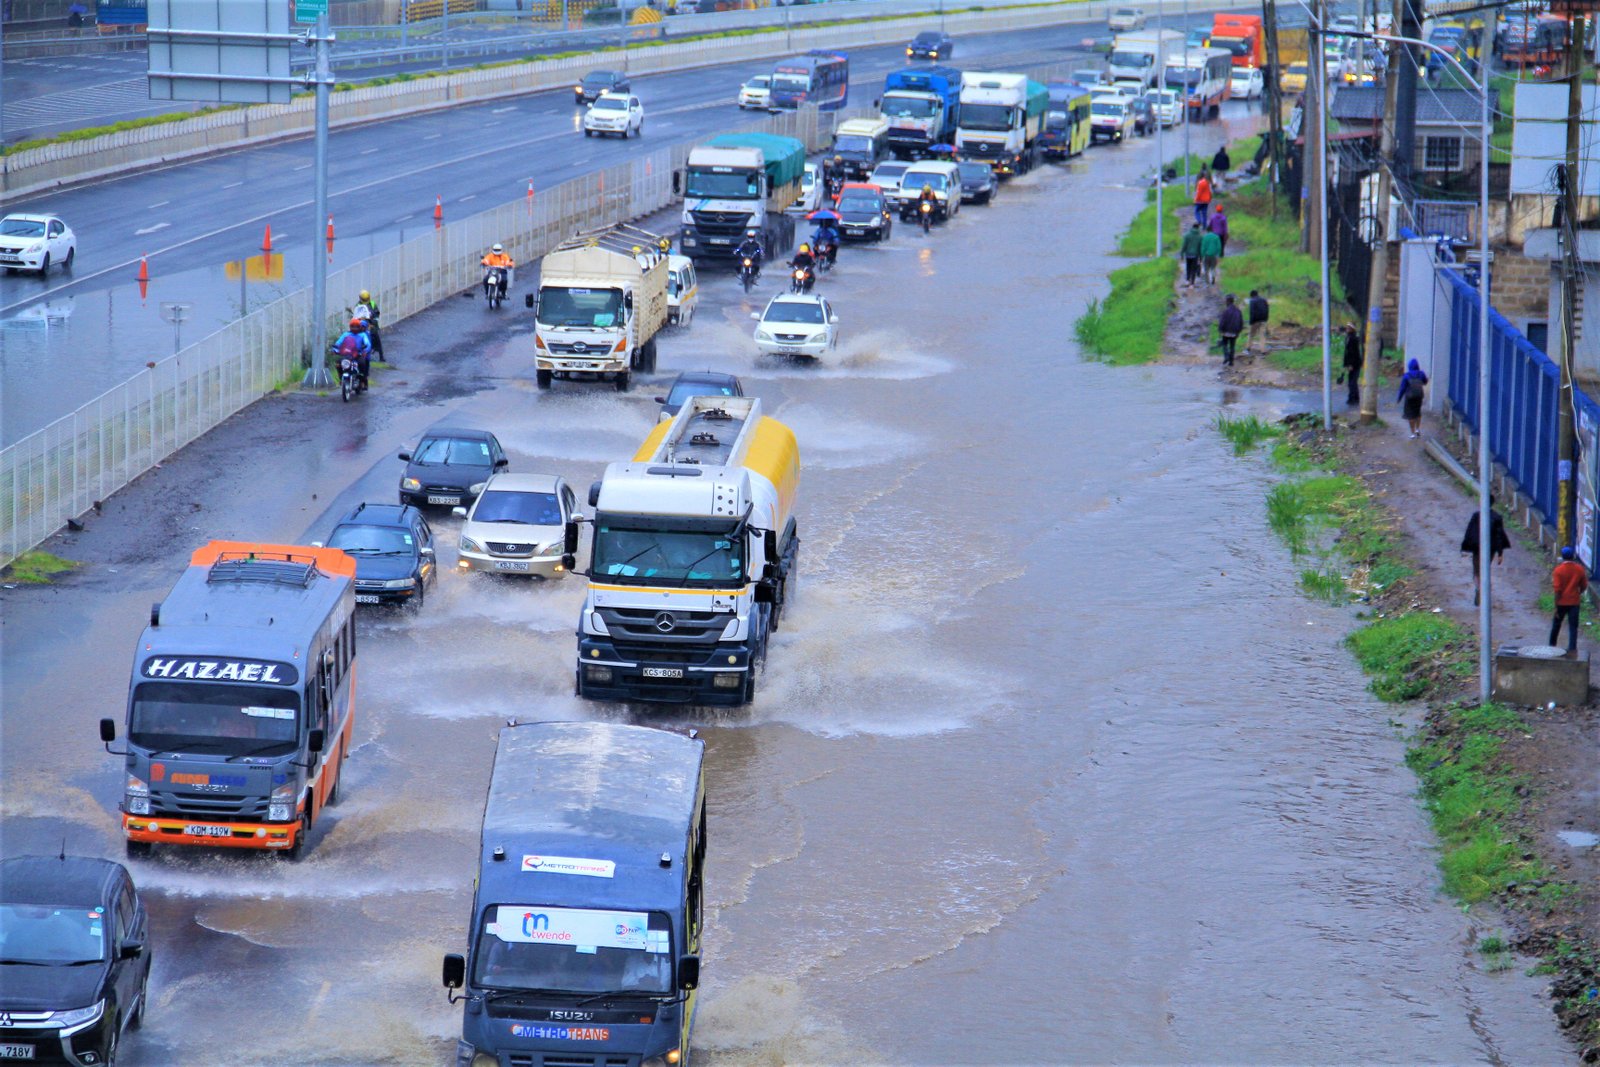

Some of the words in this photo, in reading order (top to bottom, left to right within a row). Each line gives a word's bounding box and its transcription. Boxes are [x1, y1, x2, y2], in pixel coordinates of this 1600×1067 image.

[146, 659, 282, 683] HAZAEL
[191, 783, 228, 792] ISUZU
[190, 825, 207, 834] KDM
[209, 826, 229, 836] 119W
[543, 863, 606, 872] METROTRANS
[531, 929, 571, 940] twende
[550, 1010, 594, 1020] ISUZU
[522, 1027, 609, 1040] METROTRANS
